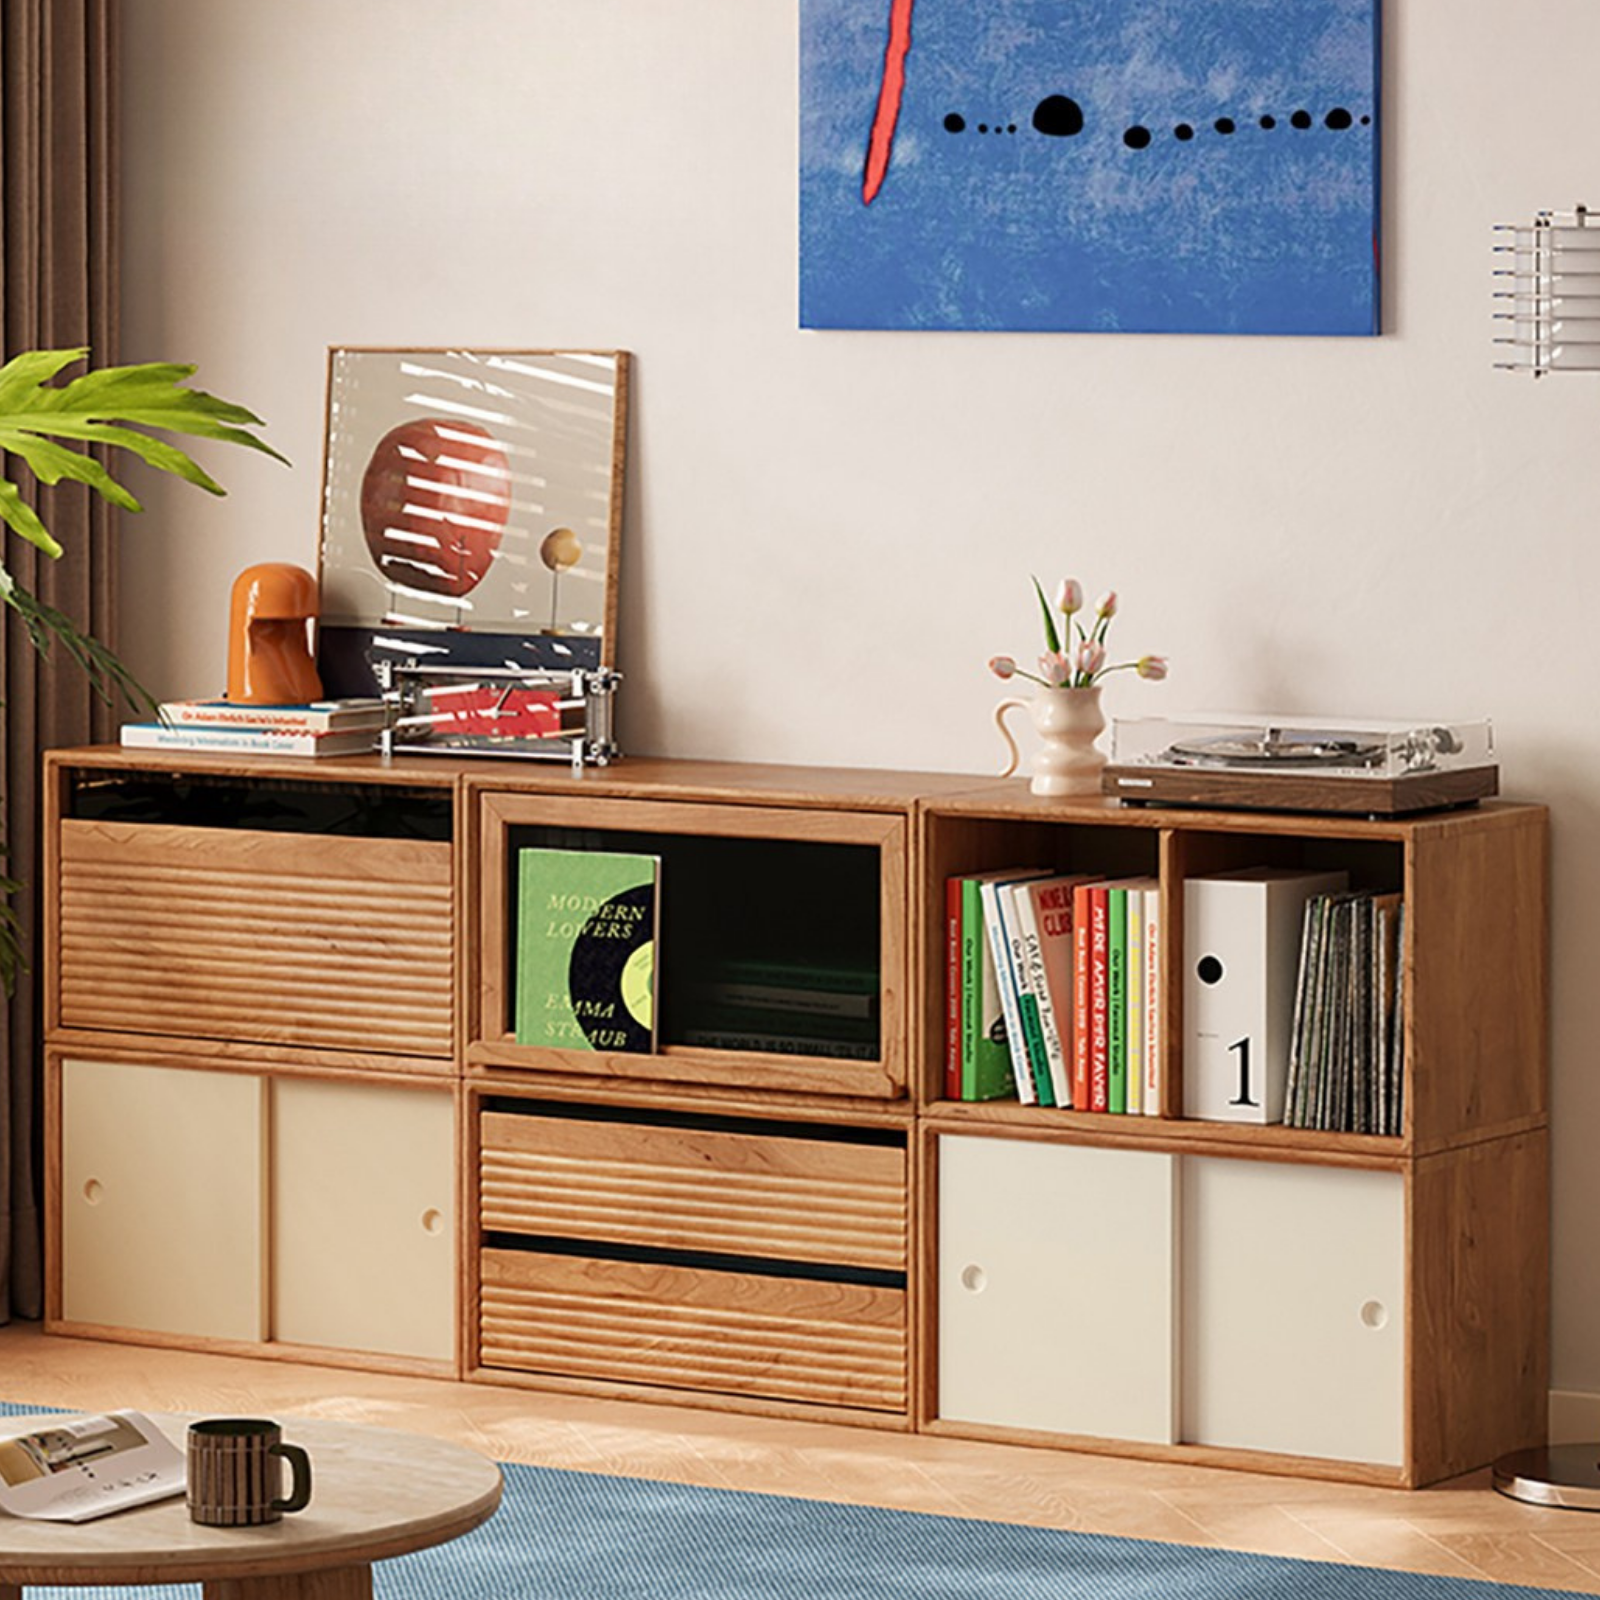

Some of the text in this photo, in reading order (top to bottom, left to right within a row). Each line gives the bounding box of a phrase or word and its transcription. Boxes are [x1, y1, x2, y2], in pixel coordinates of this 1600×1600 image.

[546, 894, 647, 922] MODERN
[545, 921, 635, 940] LOVERS
[1012, 939, 1021, 959] Our
[1112, 948, 1120, 967] Our
[1112, 970, 1120, 995] Work
[545, 994, 616, 1019] EMMA
[544, 1022, 629, 1047] STRAUB
[1227, 1036, 1260, 1107] 1
